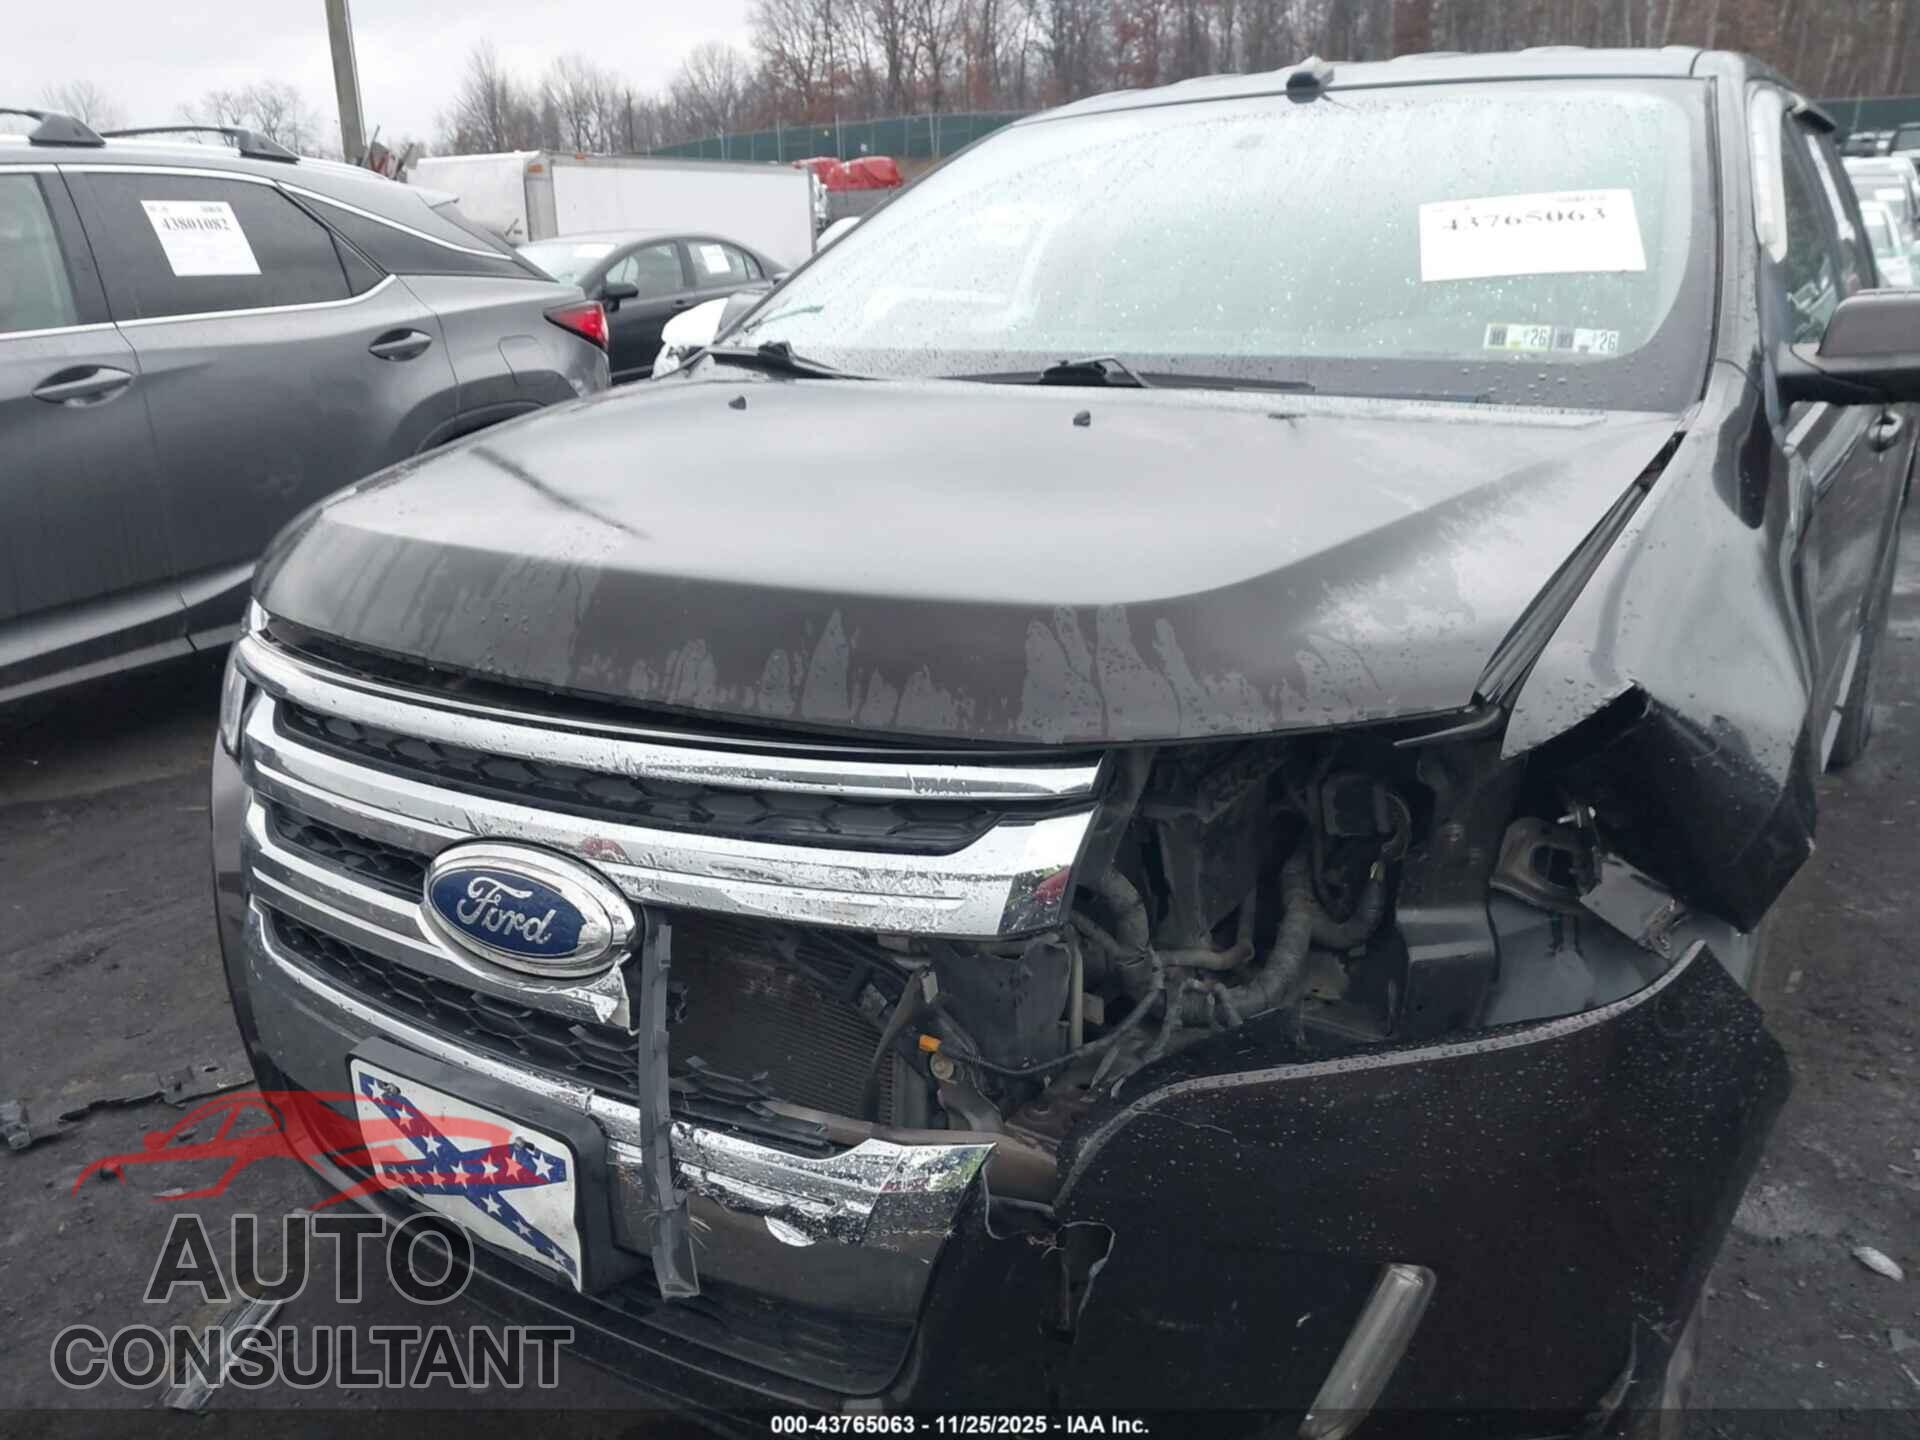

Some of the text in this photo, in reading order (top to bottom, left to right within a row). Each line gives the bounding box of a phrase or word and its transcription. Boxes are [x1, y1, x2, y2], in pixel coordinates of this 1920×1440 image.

[1442, 206, 1606, 231] 43765063
[1599, 330, 1616, 352] 26
[456, 876, 556, 944] Ford
